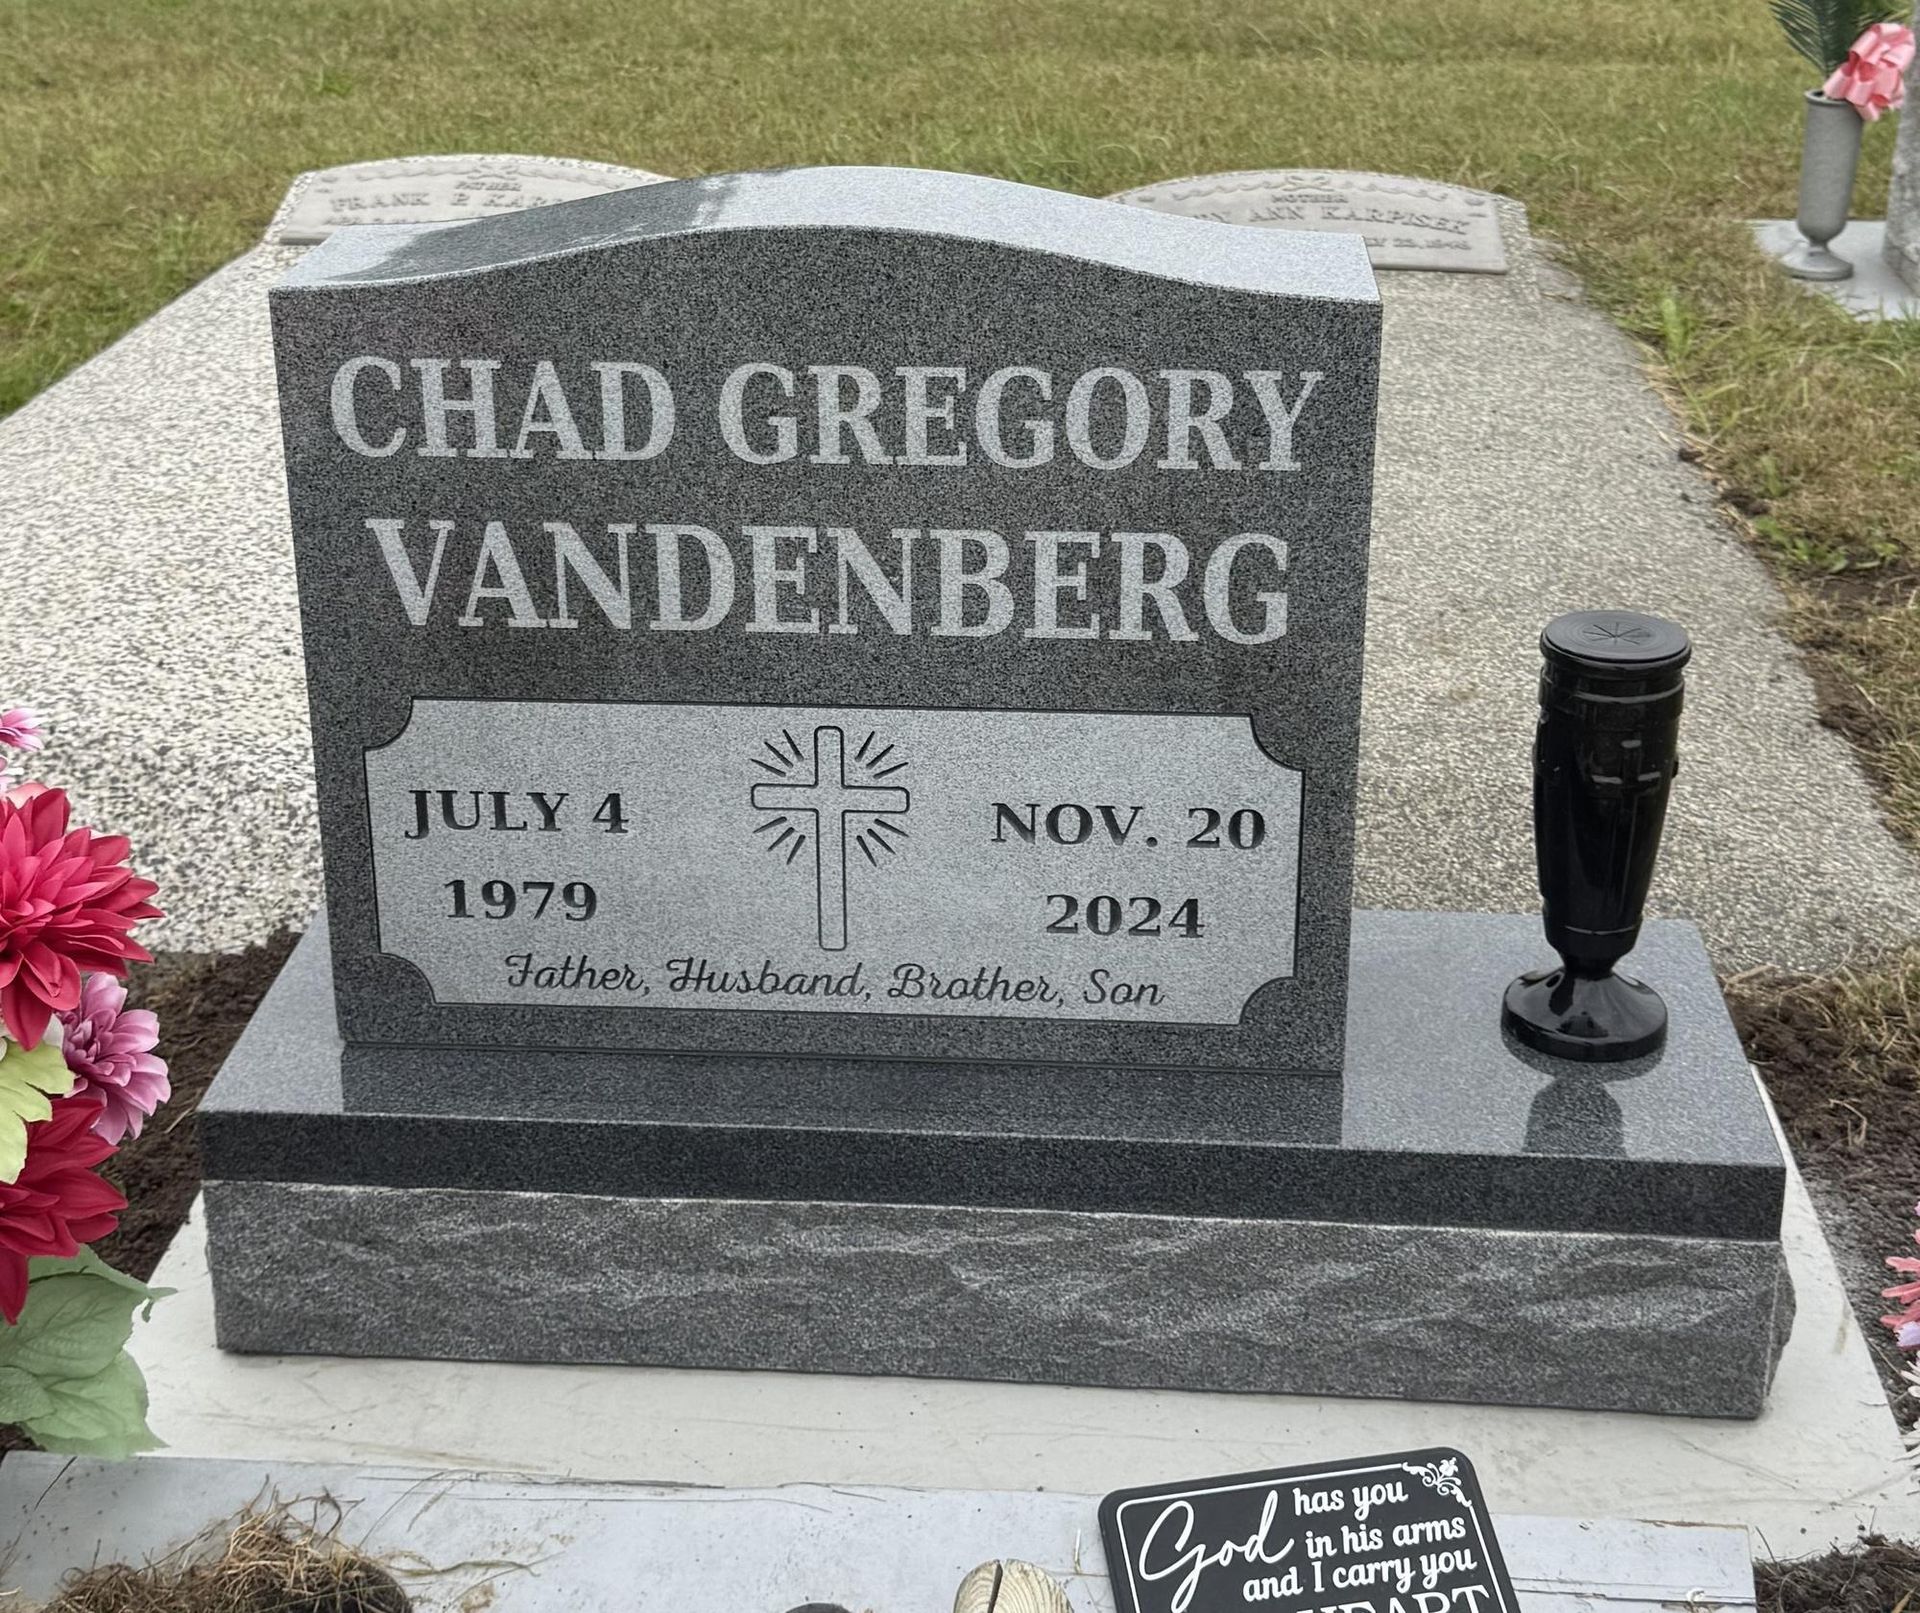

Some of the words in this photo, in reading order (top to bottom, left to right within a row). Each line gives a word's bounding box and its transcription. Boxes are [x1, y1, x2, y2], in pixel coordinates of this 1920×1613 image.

[329, 192, 432, 212] FRANK
[1248, 206, 1305, 223] ANN
[1270, 193, 1348, 203] MOTHER
[330, 355, 677, 461] CHAD
[718, 363, 1325, 472] GREGORY
[364, 516, 1289, 645] VANDENBERG
[405, 789, 570, 840] JULY
[591, 790, 630, 835] 4
[991, 801, 1158, 848] NOV.
[1187, 807, 1267, 850] 20
[443, 877, 599, 923] 1979
[1045, 893, 1206, 940] 2024
[504, 951, 651, 997] Father,
[666, 956, 874, 1003] Husband,
[888, 962, 1064, 1008] Brother,
[1083, 967, 1165, 1008] Son
[1138, 1489, 1295, 1613] God
[1292, 1487, 1345, 1517] has
[1352, 1479, 1409, 1521] you
[1305, 1531, 1337, 1559] in
[1340, 1524, 1384, 1554] his
[1391, 1516, 1467, 1546] arms
[1242, 1567, 1304, 1602] and
[1312, 1560, 1327, 1593] I
[1331, 1557, 1417, 1593] carry
[1420, 1549, 1478, 1589] you
